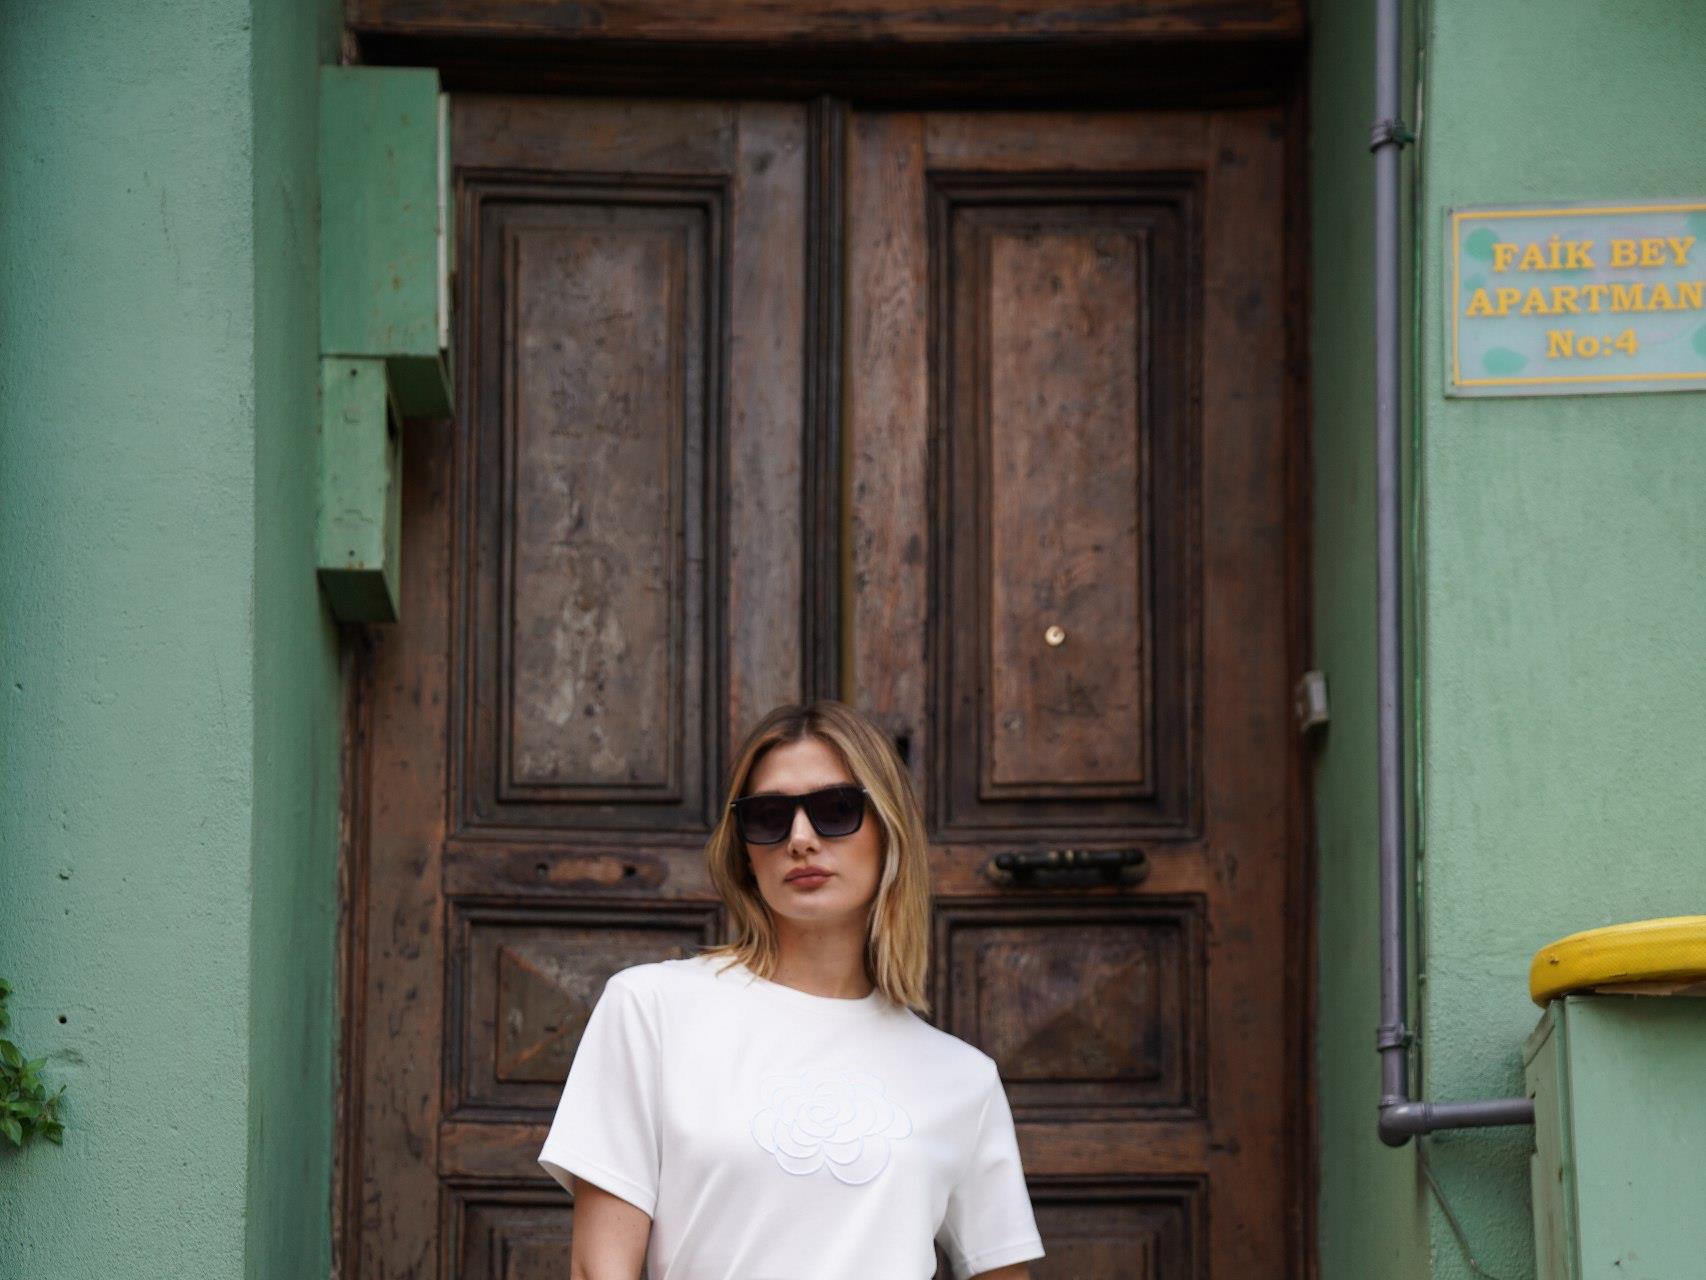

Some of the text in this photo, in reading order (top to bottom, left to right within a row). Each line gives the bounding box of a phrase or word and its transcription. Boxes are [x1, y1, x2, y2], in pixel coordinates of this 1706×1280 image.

[1492, 235, 1695, 271] FAİK BEY
[1466, 281, 1706, 316] APARTMAN
[1546, 329, 1638, 359] No:4
